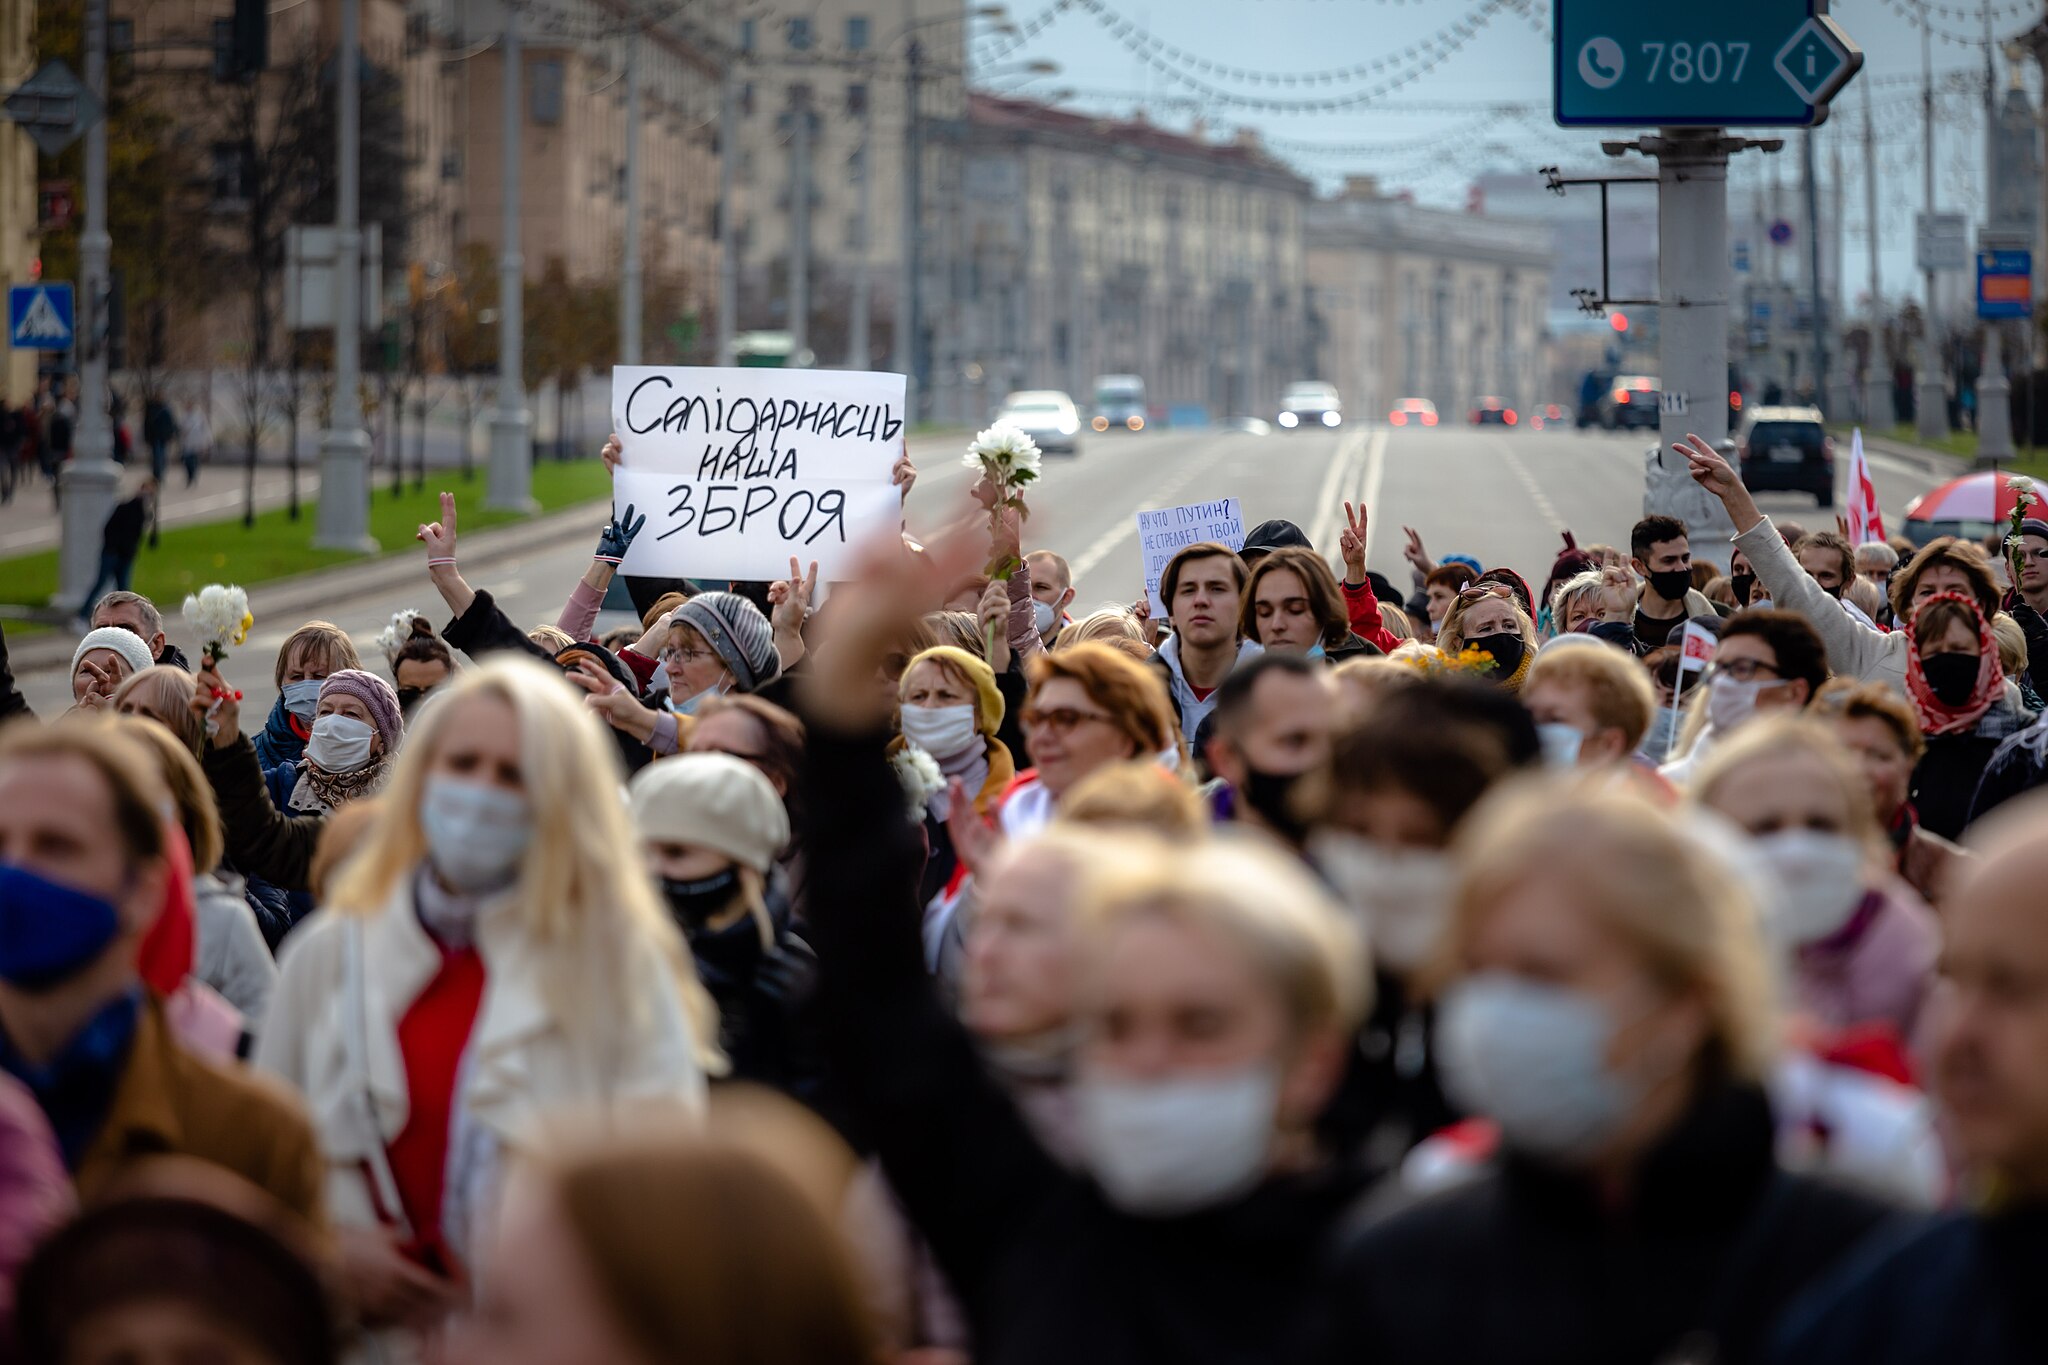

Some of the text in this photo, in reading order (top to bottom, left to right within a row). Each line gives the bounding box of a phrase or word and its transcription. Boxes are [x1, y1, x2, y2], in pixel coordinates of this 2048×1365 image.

[1641, 41, 1750, 83] 7807
[657, 484, 846, 546] ЗБРОЯ
[1140, 499, 1230, 530] НУ ЧТО ПУТИН?
[1145, 535, 1155, 550] НЕ
[1155, 527, 1199, 549] СТРЕЛЯЕТ
[1207, 517, 1241, 539] ТВОЙ
